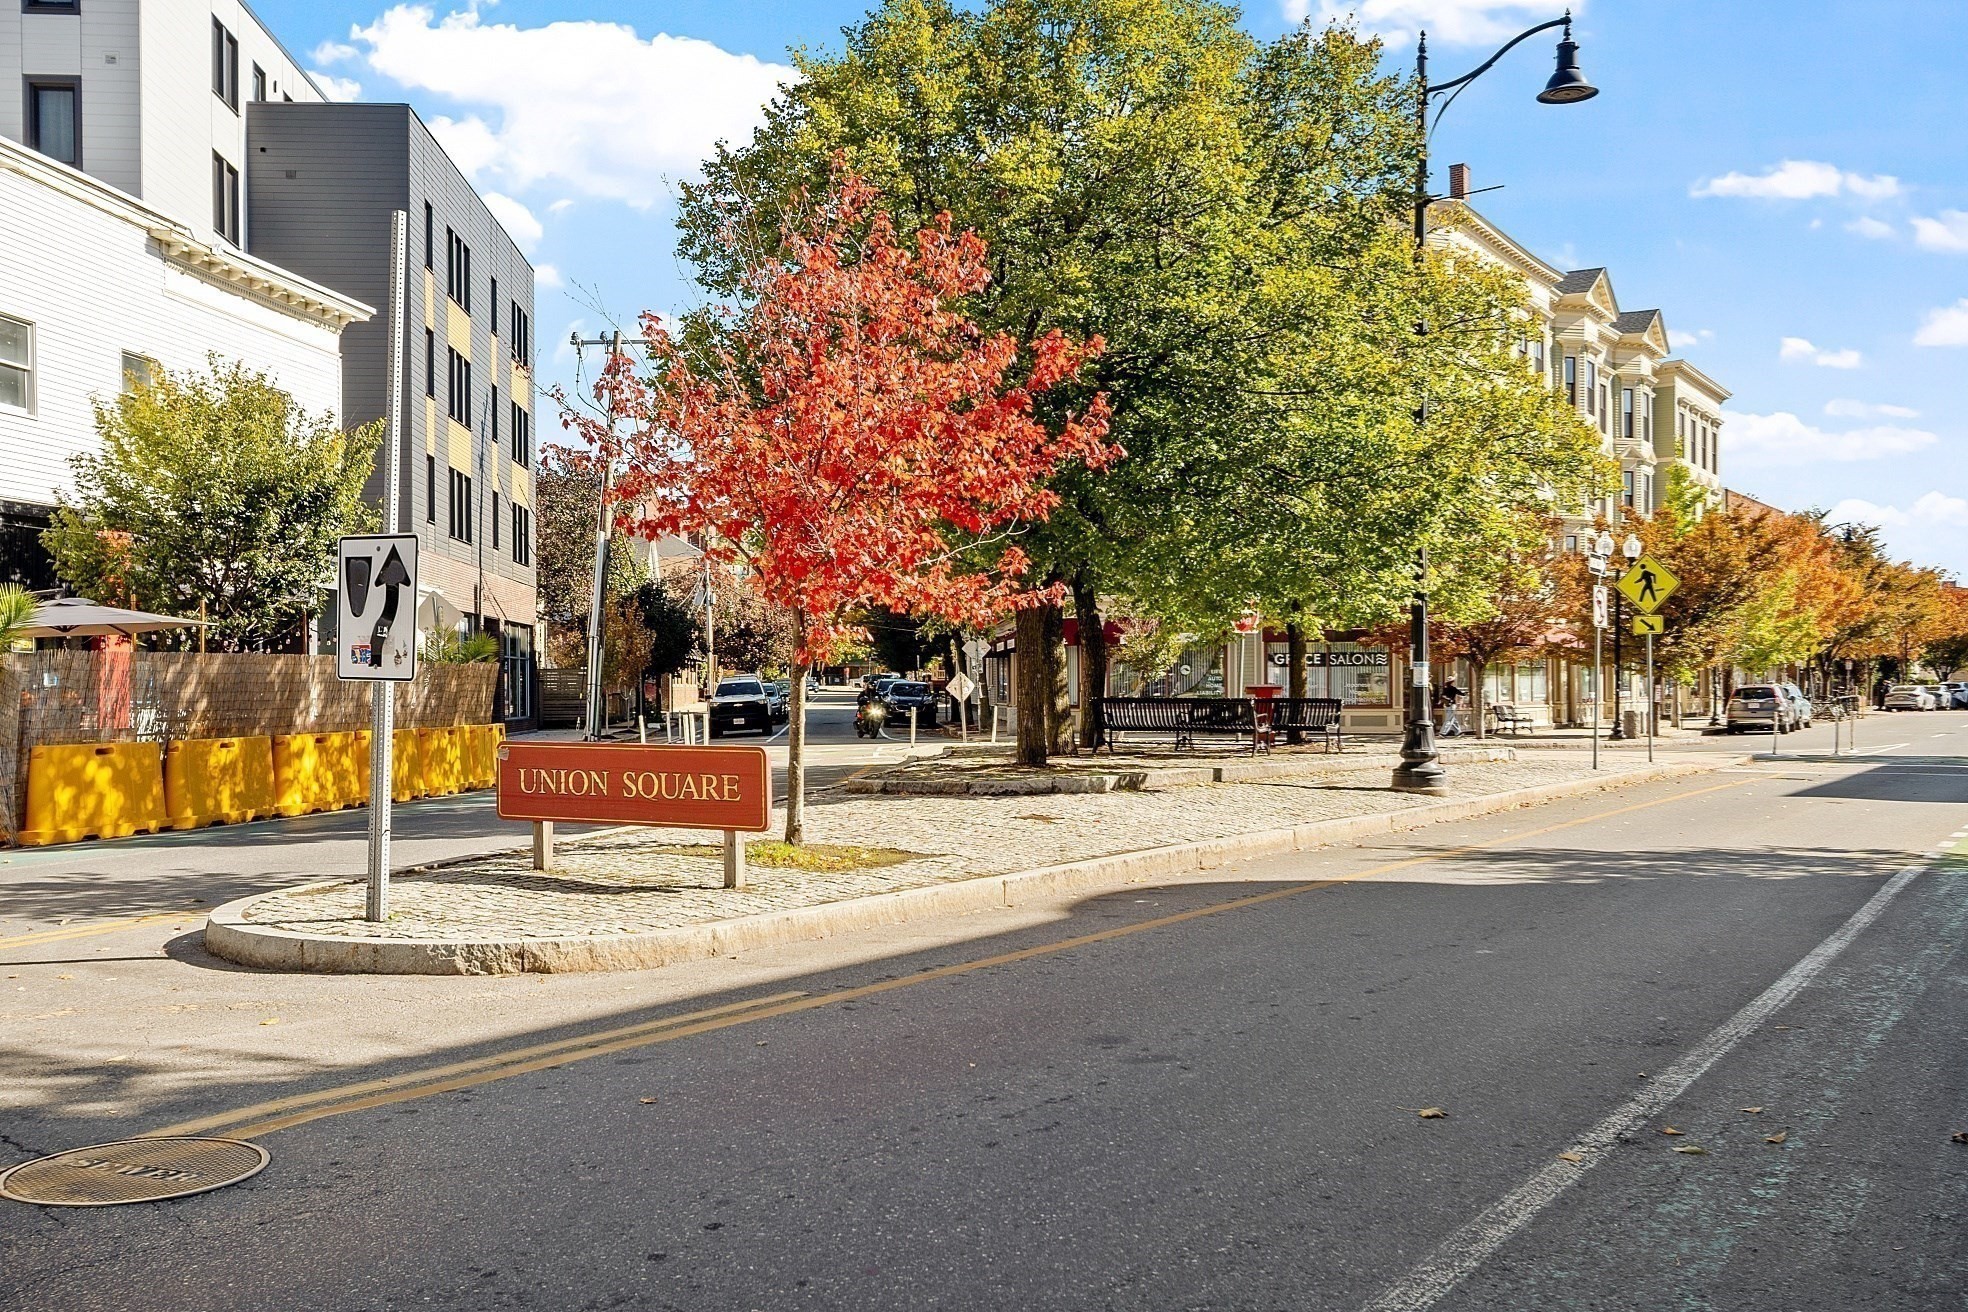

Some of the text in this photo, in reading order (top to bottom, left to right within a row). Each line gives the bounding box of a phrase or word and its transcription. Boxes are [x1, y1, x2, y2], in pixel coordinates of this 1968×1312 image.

[1274, 653, 1374, 665] GCE SALON
[518, 768, 742, 801] UNION SQUARE
[66, 1157, 200, 1182] SEWER
